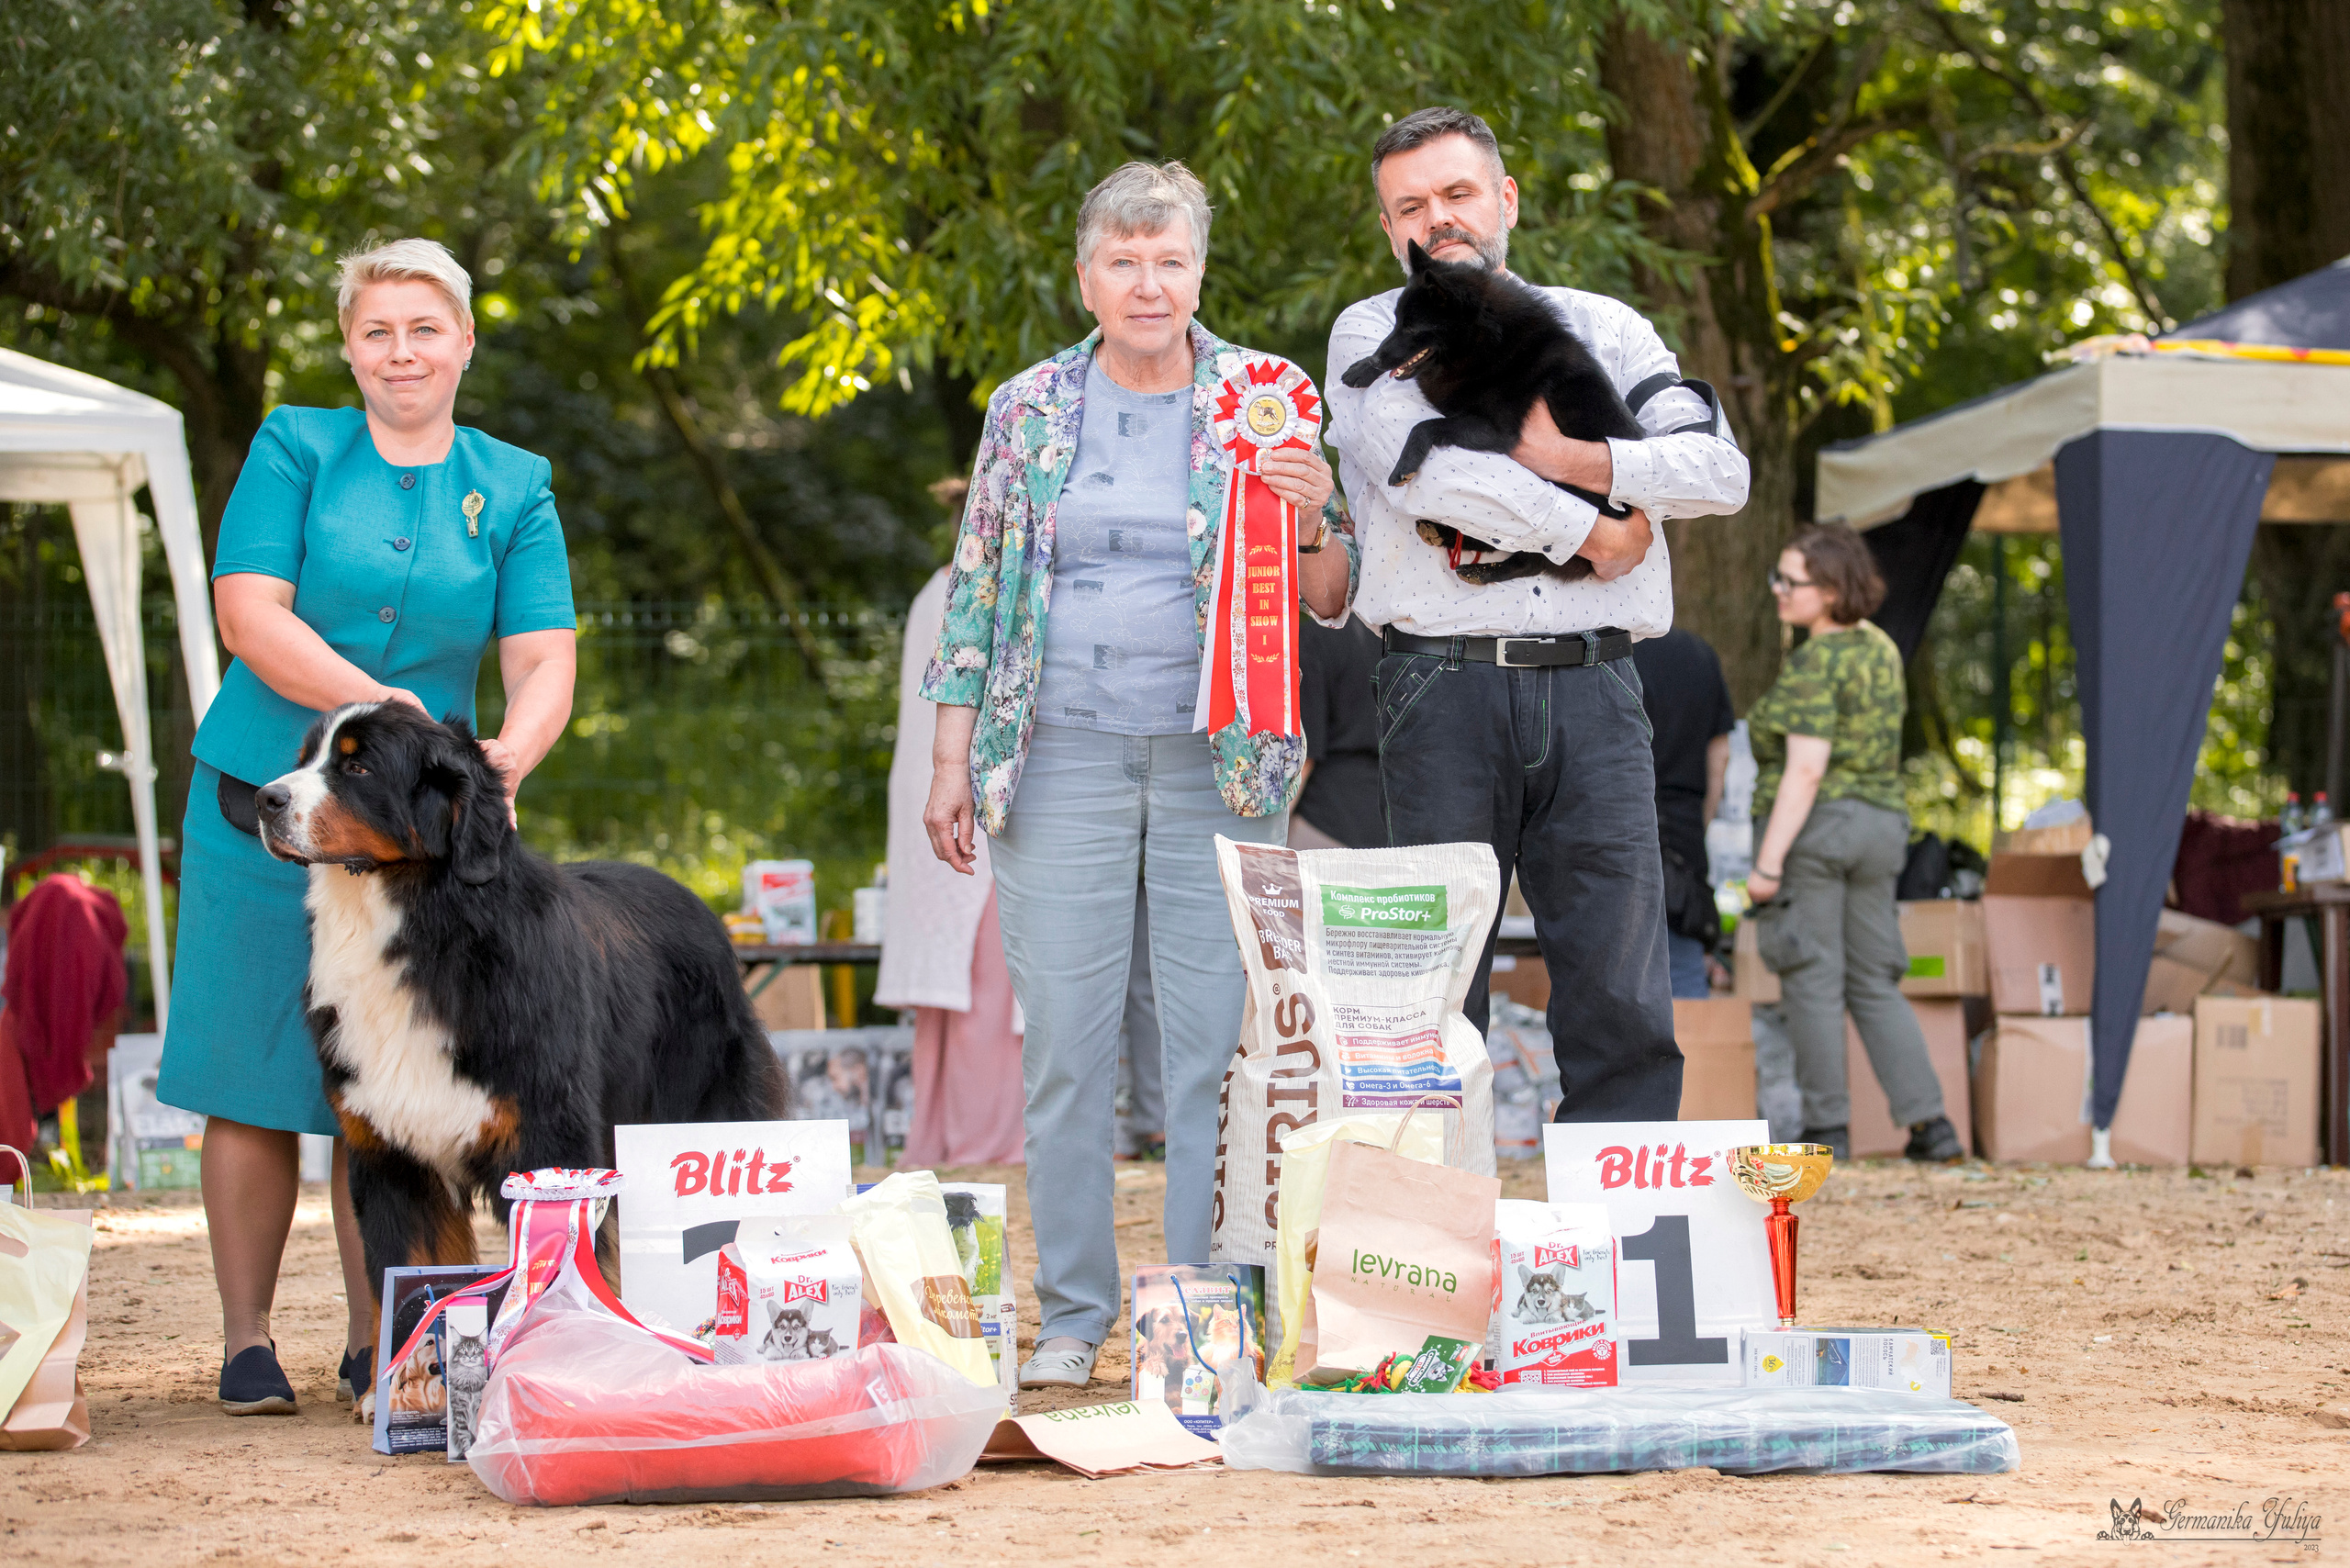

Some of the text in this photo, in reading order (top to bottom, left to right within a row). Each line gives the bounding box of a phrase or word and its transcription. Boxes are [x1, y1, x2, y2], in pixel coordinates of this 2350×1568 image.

[1248, 566, 1280, 578] JUNIOR
[1252, 583, 1275, 593] BEST
[1259, 599, 1269, 610] IN
[1250, 616, 1278, 626] SHOW
[1248, 896, 1299, 909] PREMIUM
[1331, 890, 1436, 905] Комплекс пробиотиков
[1262, 909, 1285, 918] FOOD
[1360, 907, 1431, 922] ProStor+
[1326, 928, 1454, 943] Бережно восстанавливает нормальную
[1326, 937, 1458, 952] микрофлору пищеварительной системы
[1356, 951, 1393, 960] витаминов,
[1394, 951, 1432, 960] активирует
[1356, 960, 1390, 969] иммунной
[1328, 966, 1377, 977] Поддерживает
[1379, 969, 1410, 979] здоровье
[1335, 1010, 1427, 1024] ПРЕМИУМ-КЛАССА
[1353, 1037, 1409, 1047] Поддерживает
[1403, 1048, 1434, 1060] волокна
[1400, 1081, 1431, 1089] Омега-6
[1361, 1098, 1398, 1106] Здоровая
[670, 1147, 796, 1198] Blitz
[1595, 1141, 1716, 1191] Blitz
[770, 1249, 827, 1264] Коврики
[1539, 1248, 1575, 1265] ALEX
[1352, 1249, 1457, 1294] levrana
[798, 1275, 813, 1283] Dr.
[788, 1282, 823, 1301] ALEX
[1350, 1276, 1451, 1302] NATURAL
[1621, 1215, 1729, 1366] 1
[1513, 1322, 1606, 1358] Коврики
[1044, 1401, 1141, 1422] levrana
